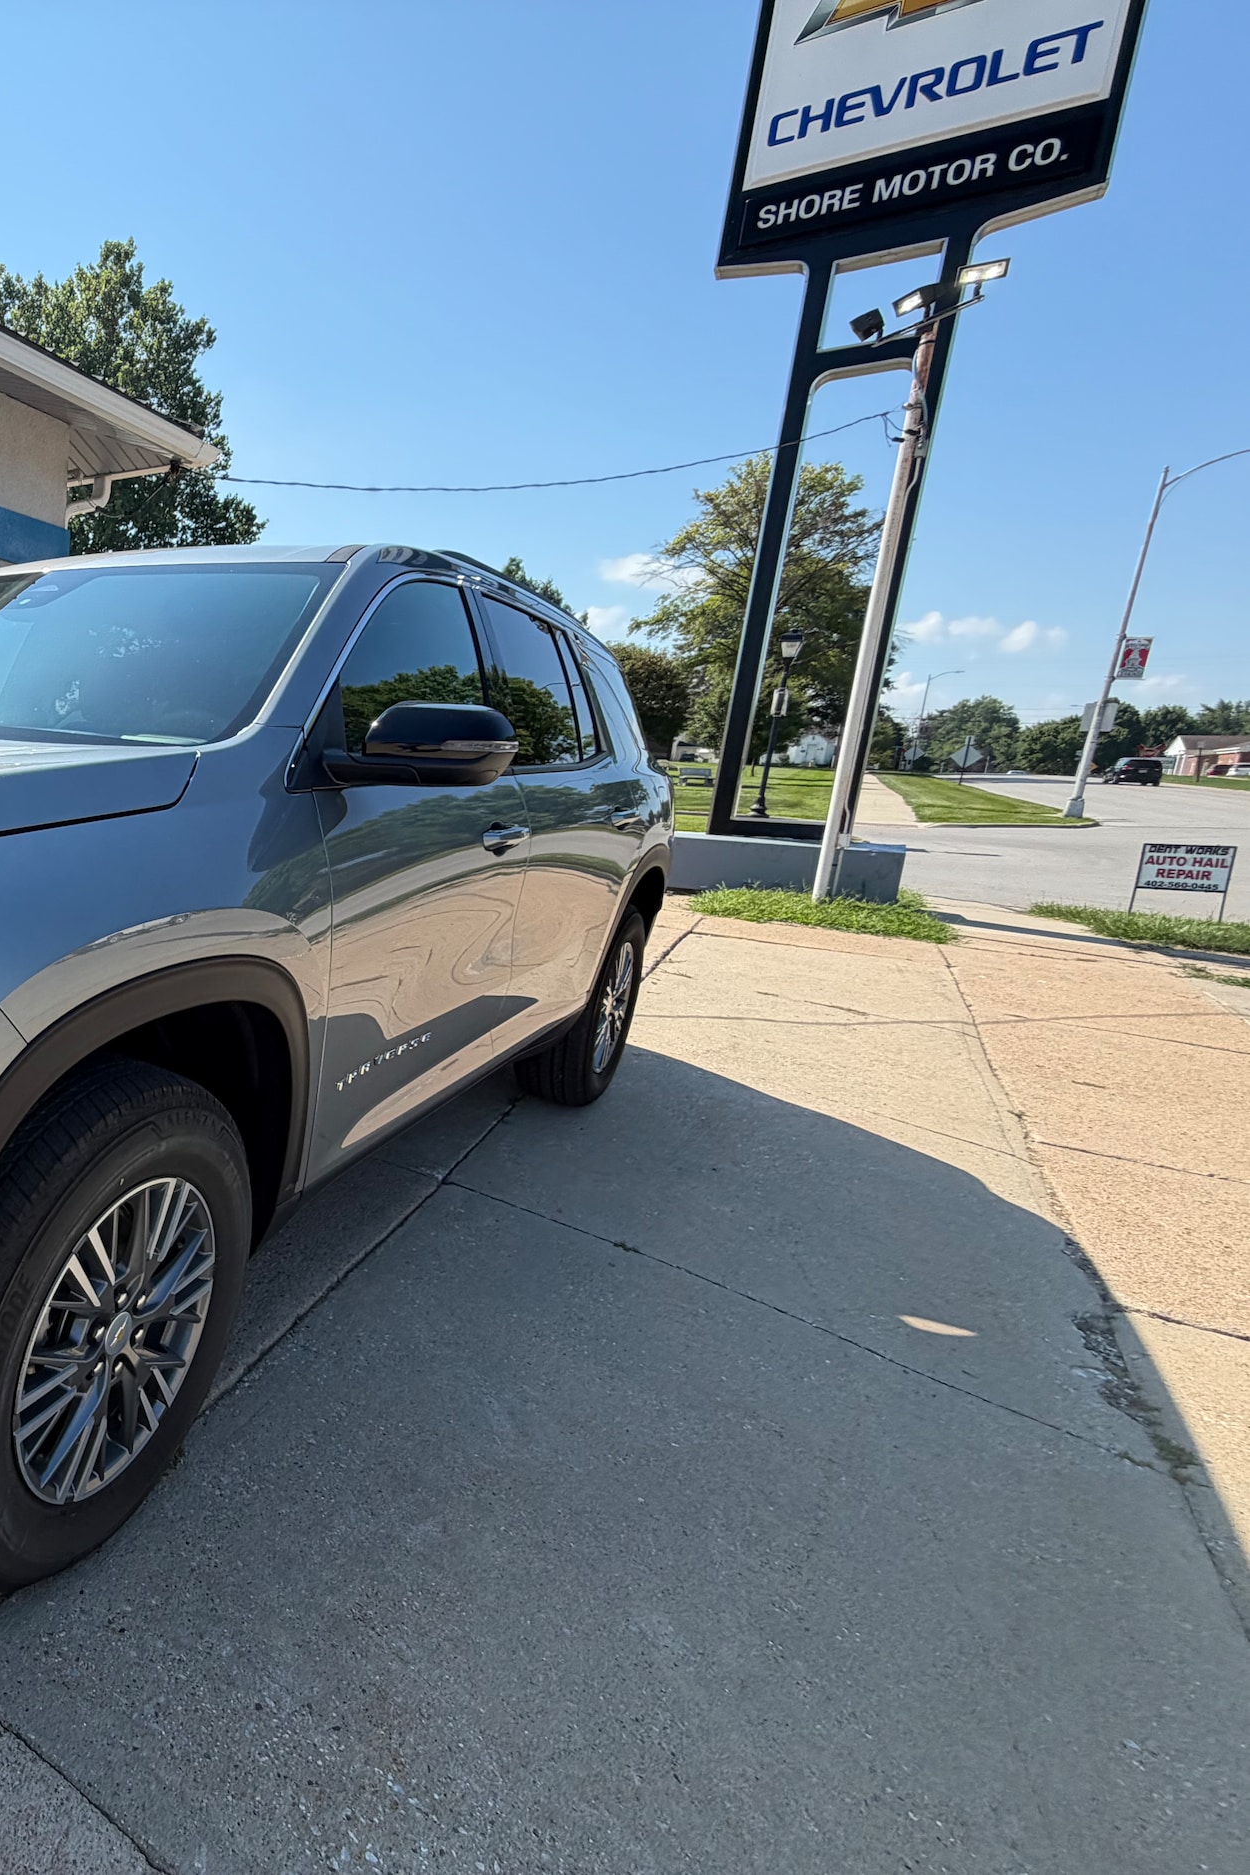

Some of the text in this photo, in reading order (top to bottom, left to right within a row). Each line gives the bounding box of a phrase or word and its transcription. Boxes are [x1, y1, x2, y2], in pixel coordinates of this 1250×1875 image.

[766, 20, 1104, 147] CHEVROLET
[756, 137, 1070, 230] SHORE MOTOR CO.
[1148, 844, 1230, 856] DENT WORKS
[1144, 855, 1230, 869] AUTO HAIL
[1155, 868, 1212, 881] REPAIR
[1144, 880, 1219, 891] 402-560-0445
[335, 1032, 432, 1092] TRAVERSE
